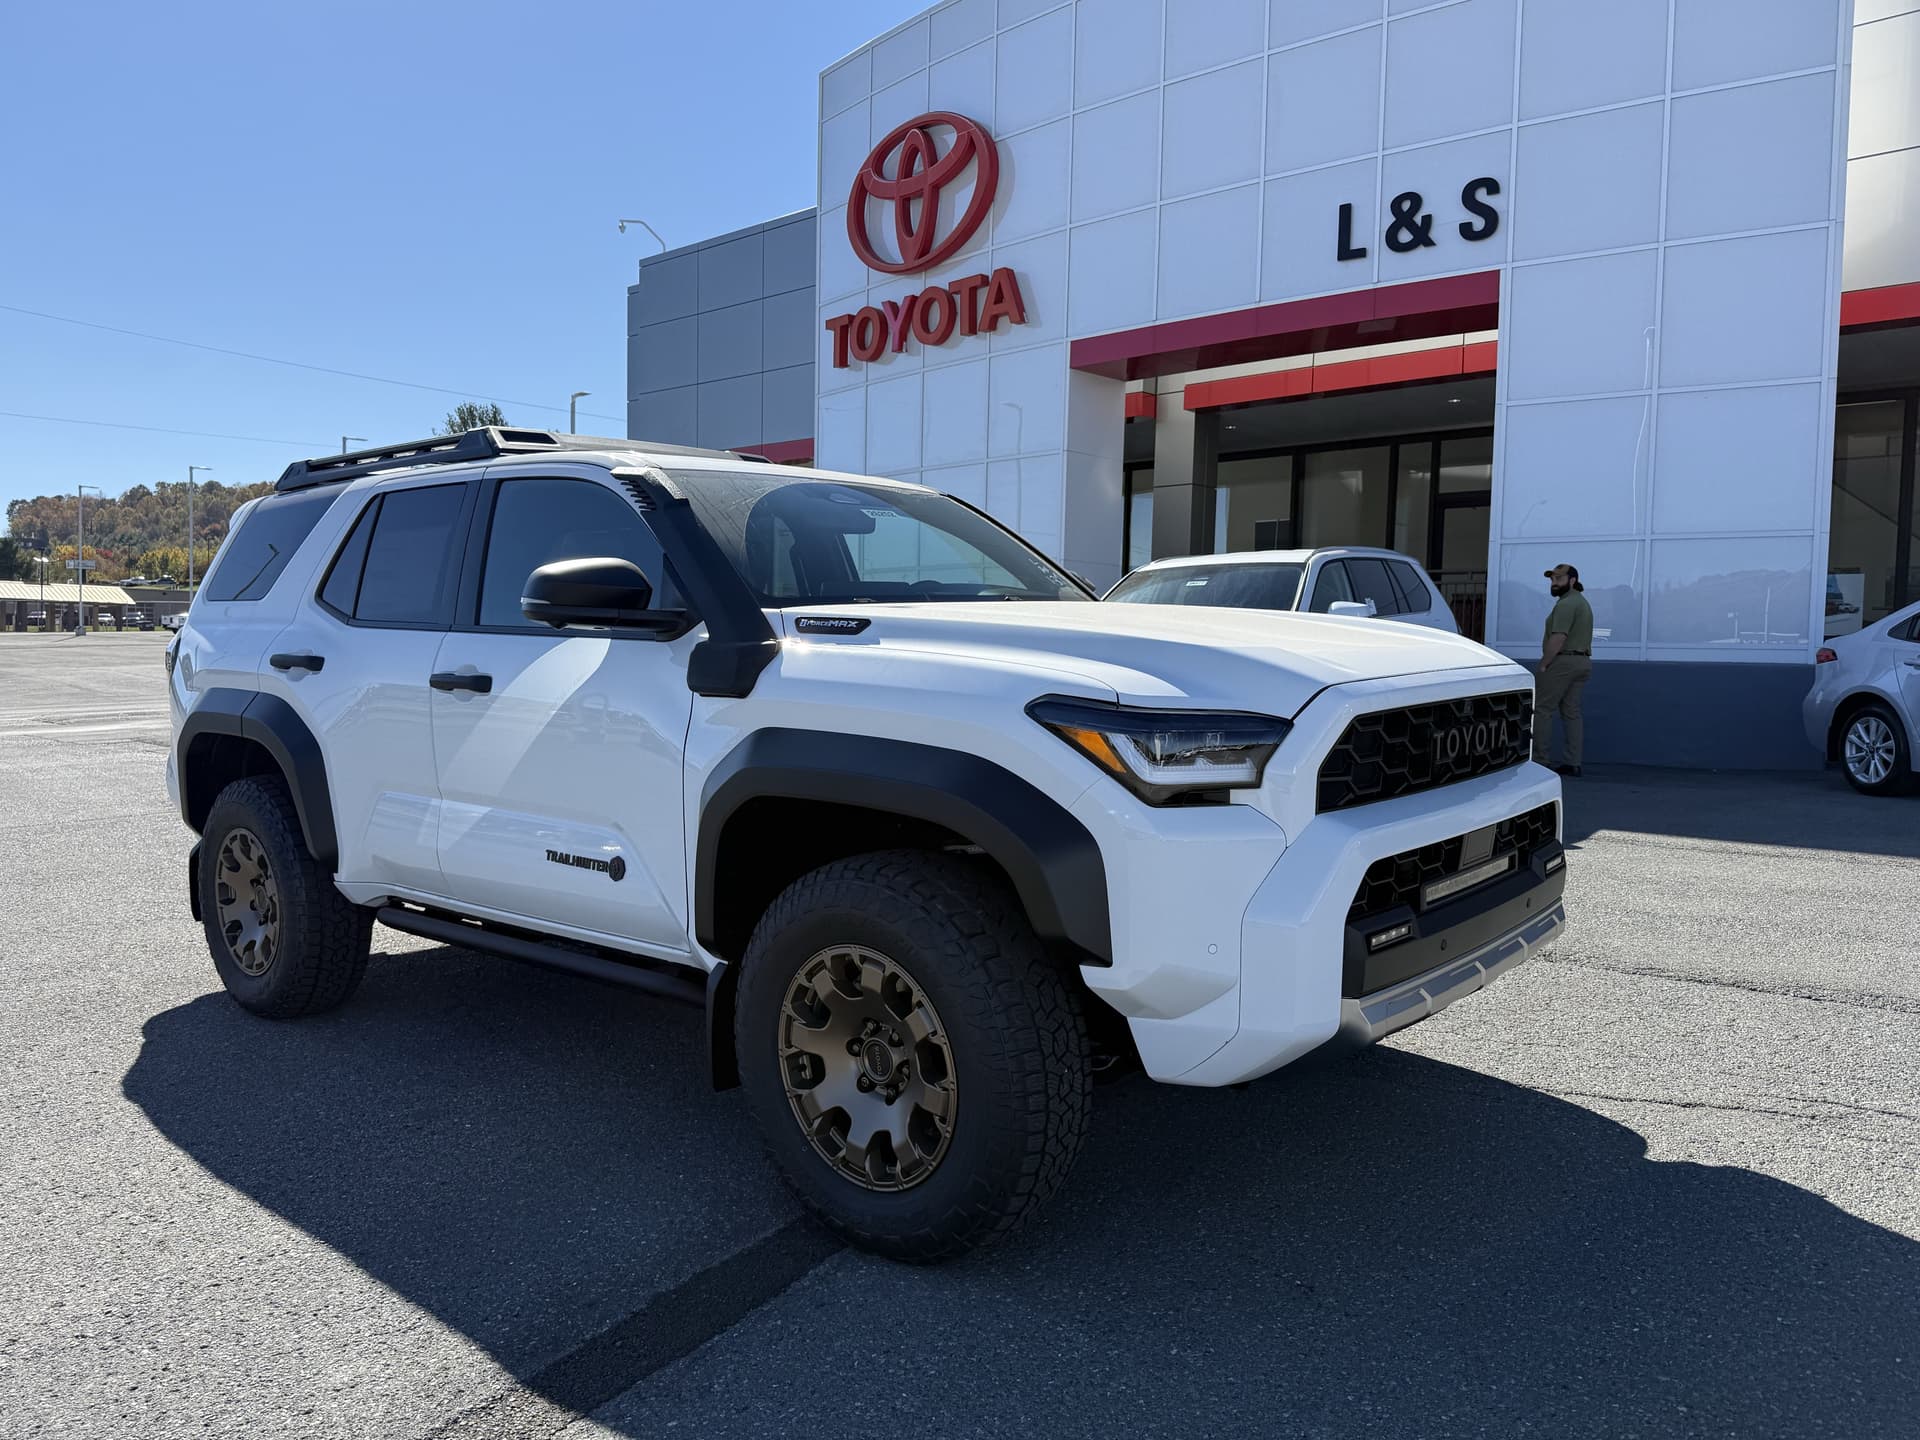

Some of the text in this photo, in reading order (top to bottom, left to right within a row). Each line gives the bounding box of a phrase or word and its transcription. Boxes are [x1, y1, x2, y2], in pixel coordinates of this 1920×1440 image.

[1337, 177, 1500, 261] L & S
[825, 267, 1028, 369] TOYOTA
[1433, 718, 1508, 760] TOYOTA
[545, 850, 608, 873] TRAILHUNTER
